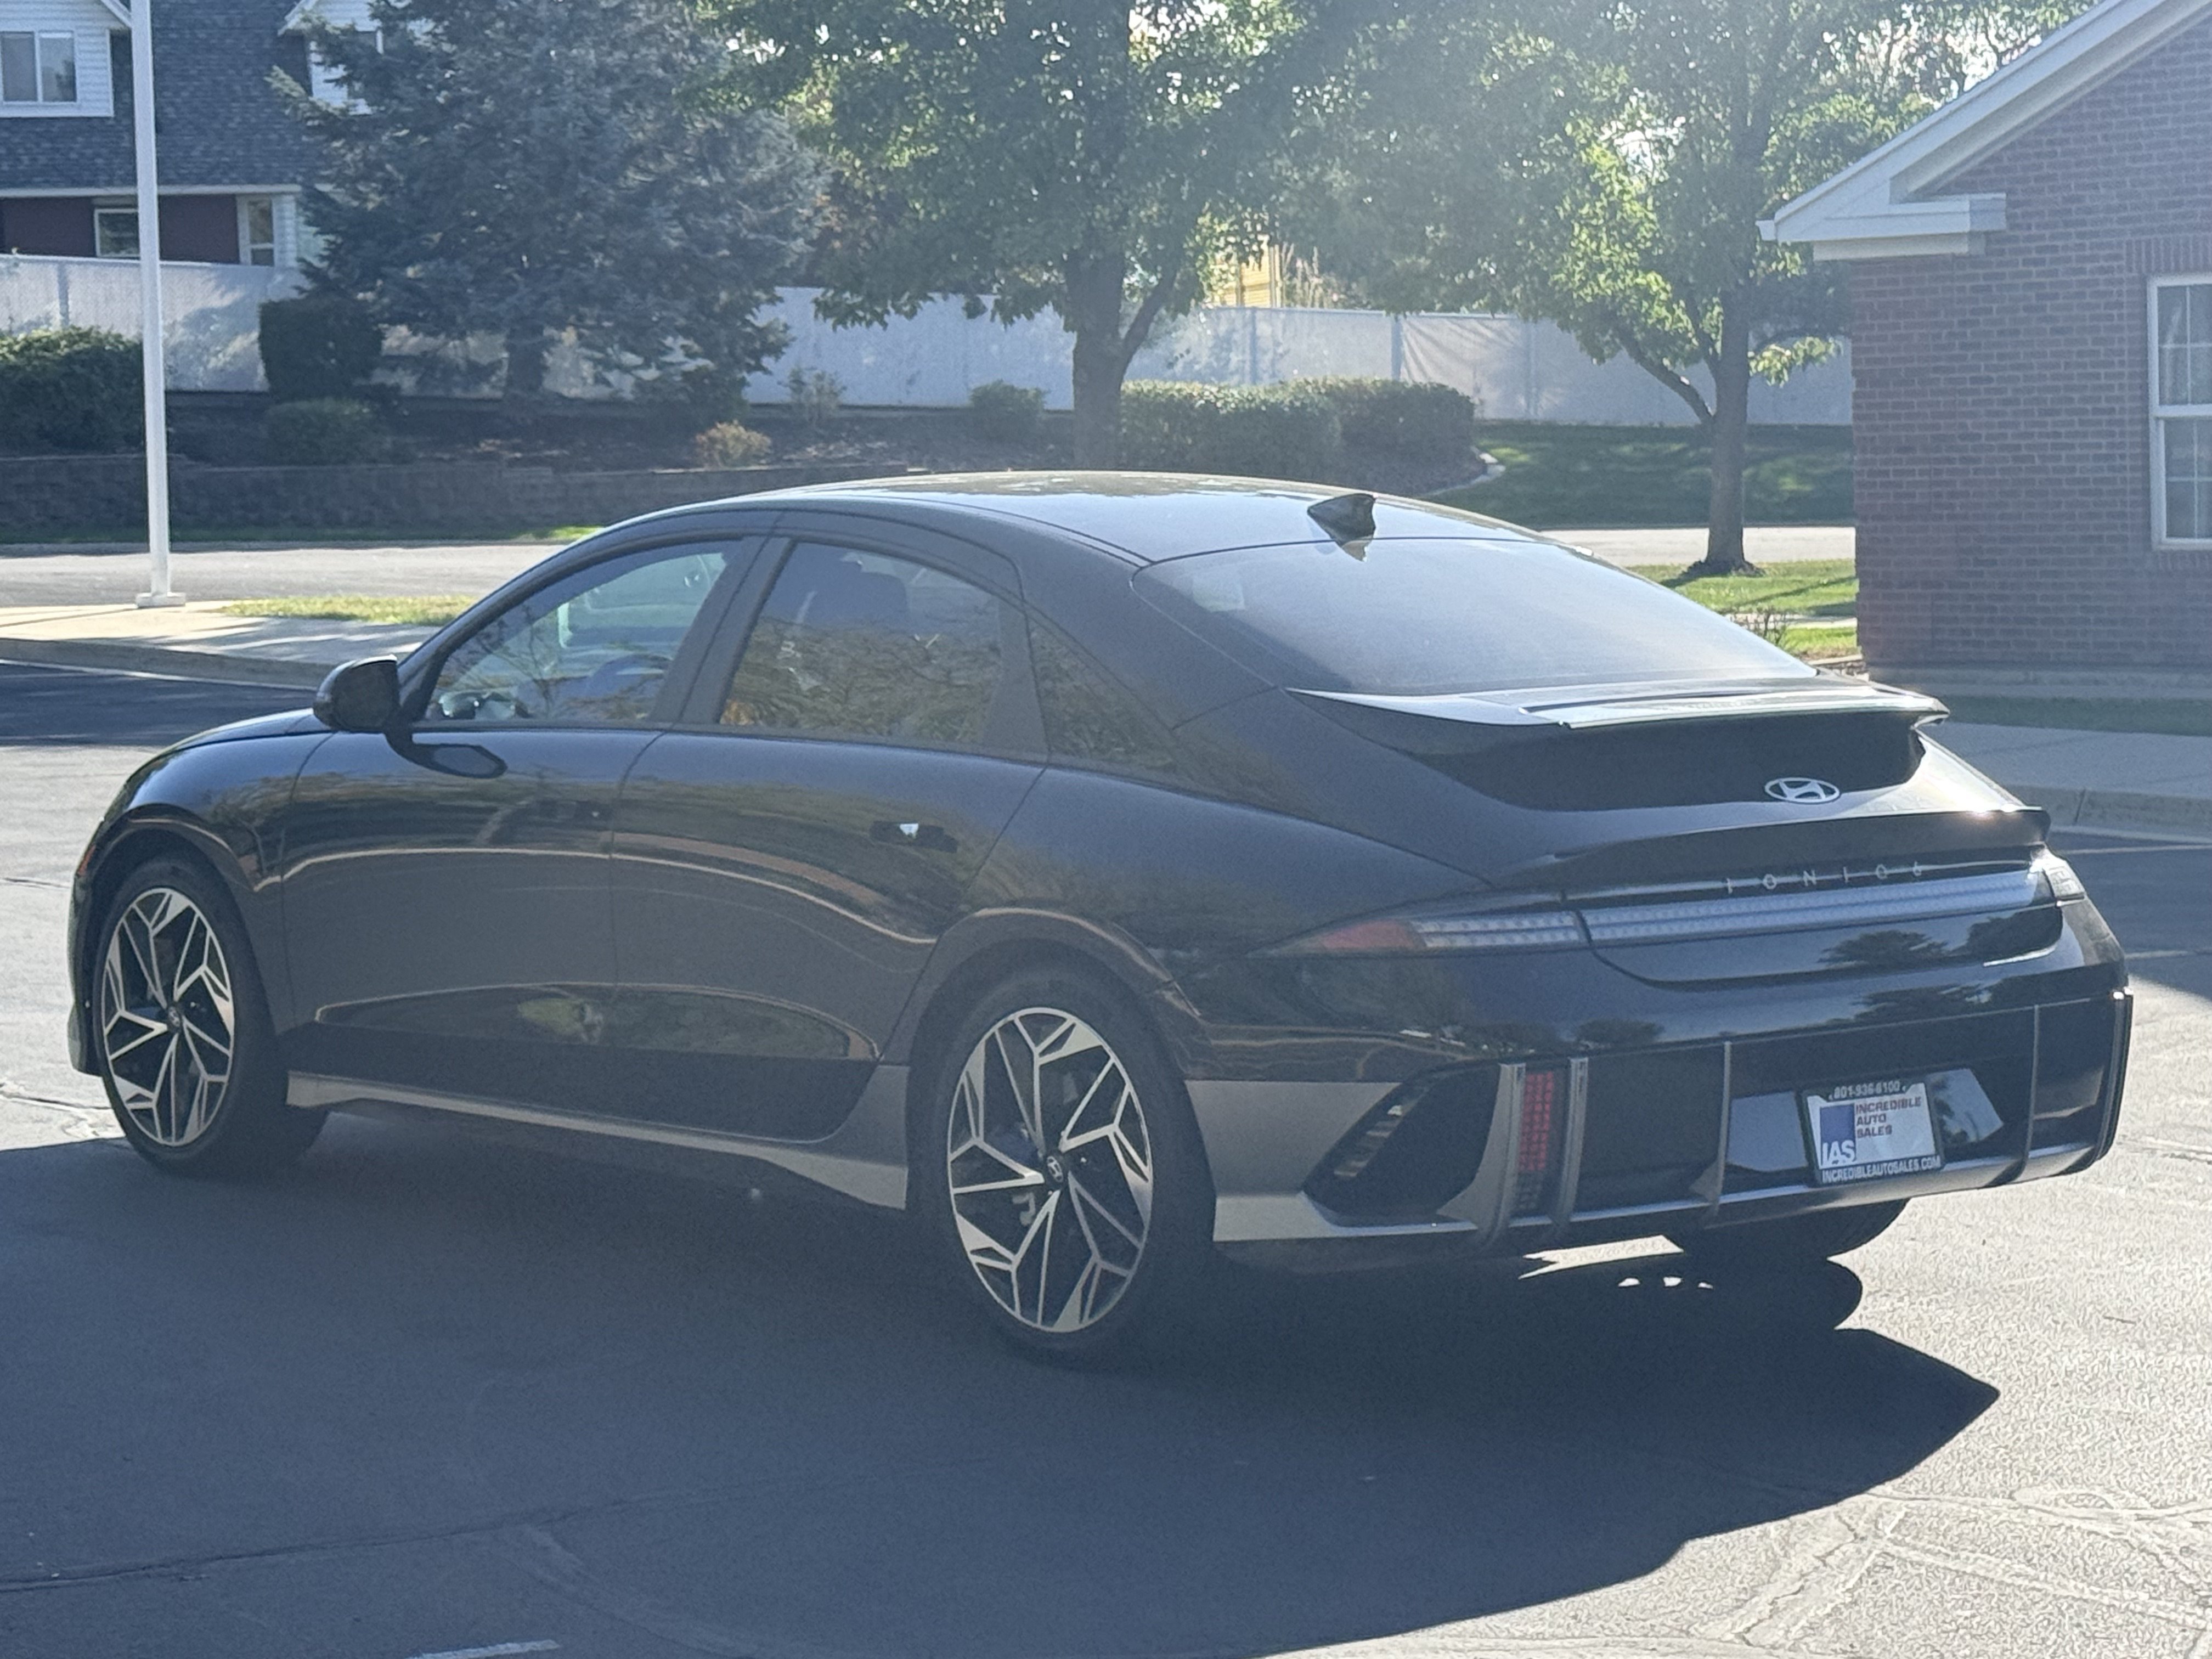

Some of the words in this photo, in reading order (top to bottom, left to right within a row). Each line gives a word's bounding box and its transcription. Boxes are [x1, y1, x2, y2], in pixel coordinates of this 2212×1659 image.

[1856, 1097, 1921, 1114] INCREDIBLE
[1857, 1114, 1887, 1126] AUTO
[1857, 1125, 1892, 1138] SALES
[1822, 1140, 1856, 1166] IAS
[1822, 1155, 1941, 1183] INCREDIBLEAUTOSALES.COM
